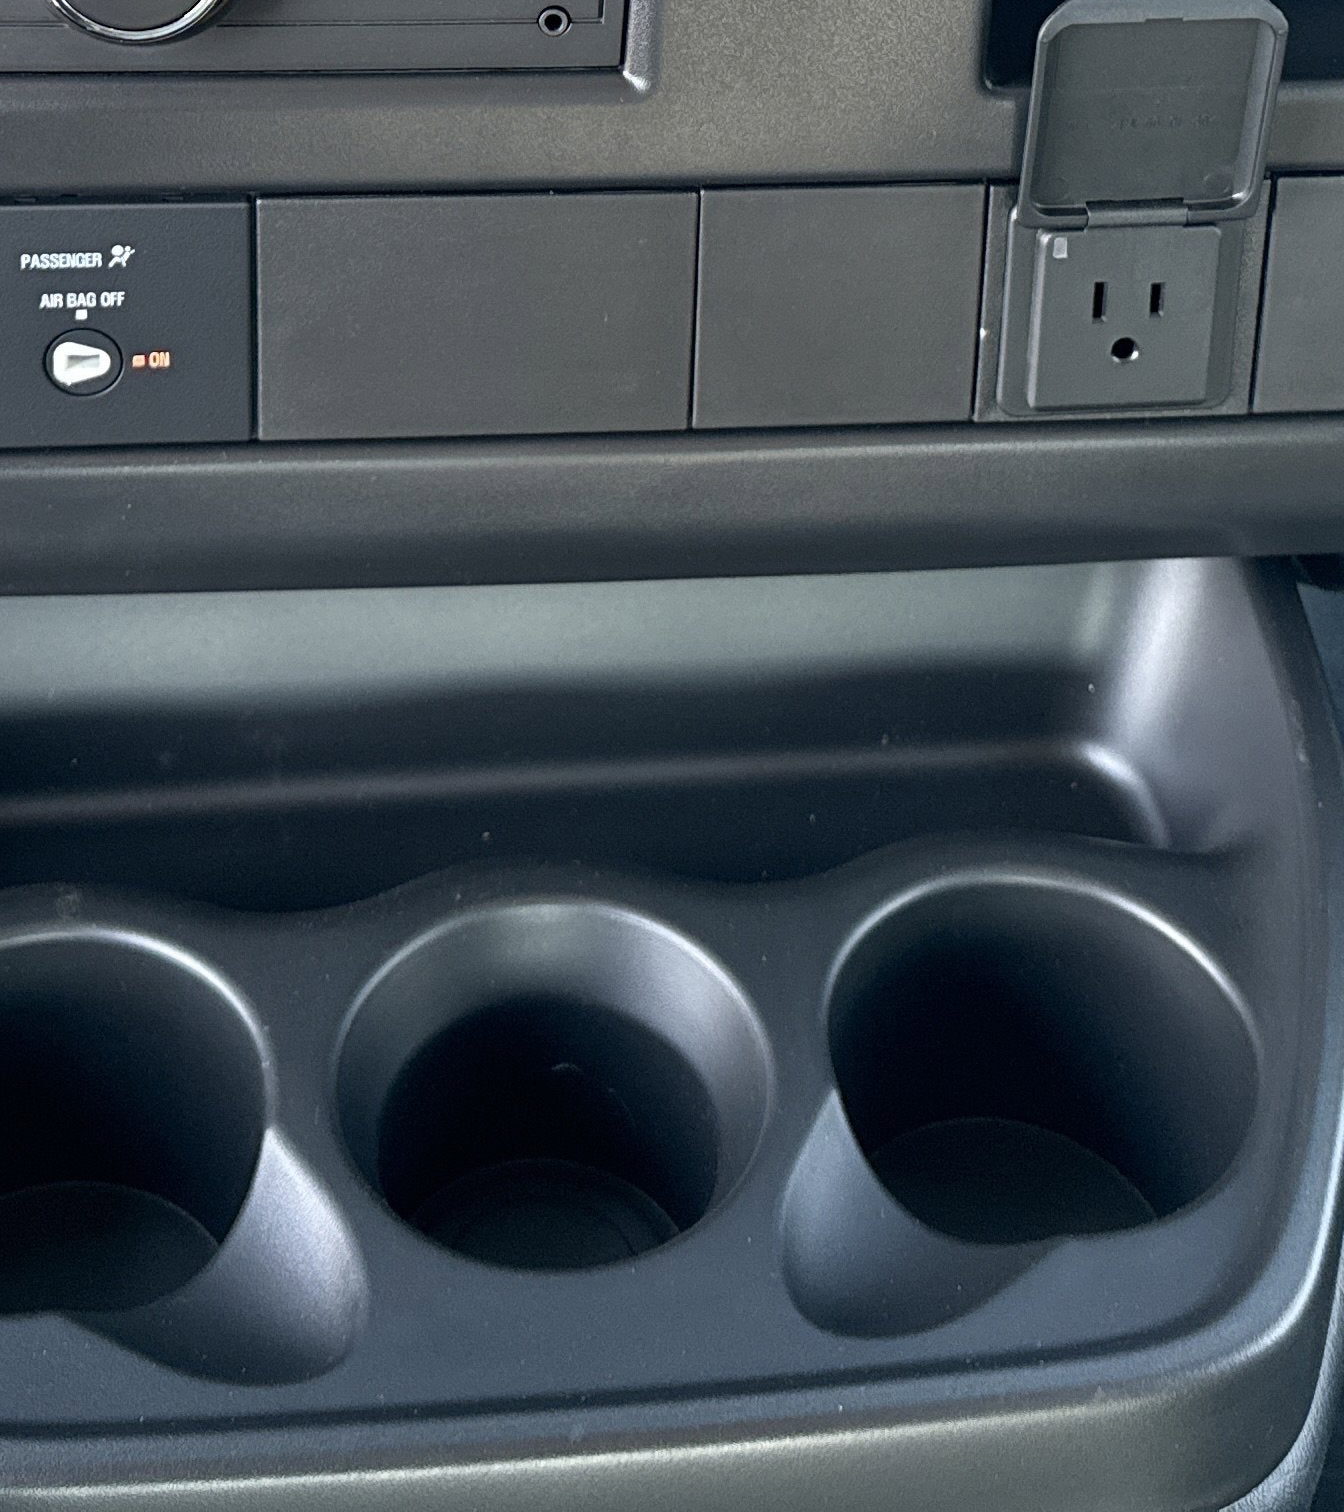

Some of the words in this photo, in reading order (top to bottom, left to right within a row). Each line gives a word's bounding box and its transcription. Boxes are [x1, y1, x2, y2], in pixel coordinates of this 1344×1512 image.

[20, 252, 103, 270] PASSENGER
[39, 293, 64, 309] AIR
[66, 292, 97, 308] BAG
[100, 291, 125, 307] OFF
[148, 351, 171, 369] ON
